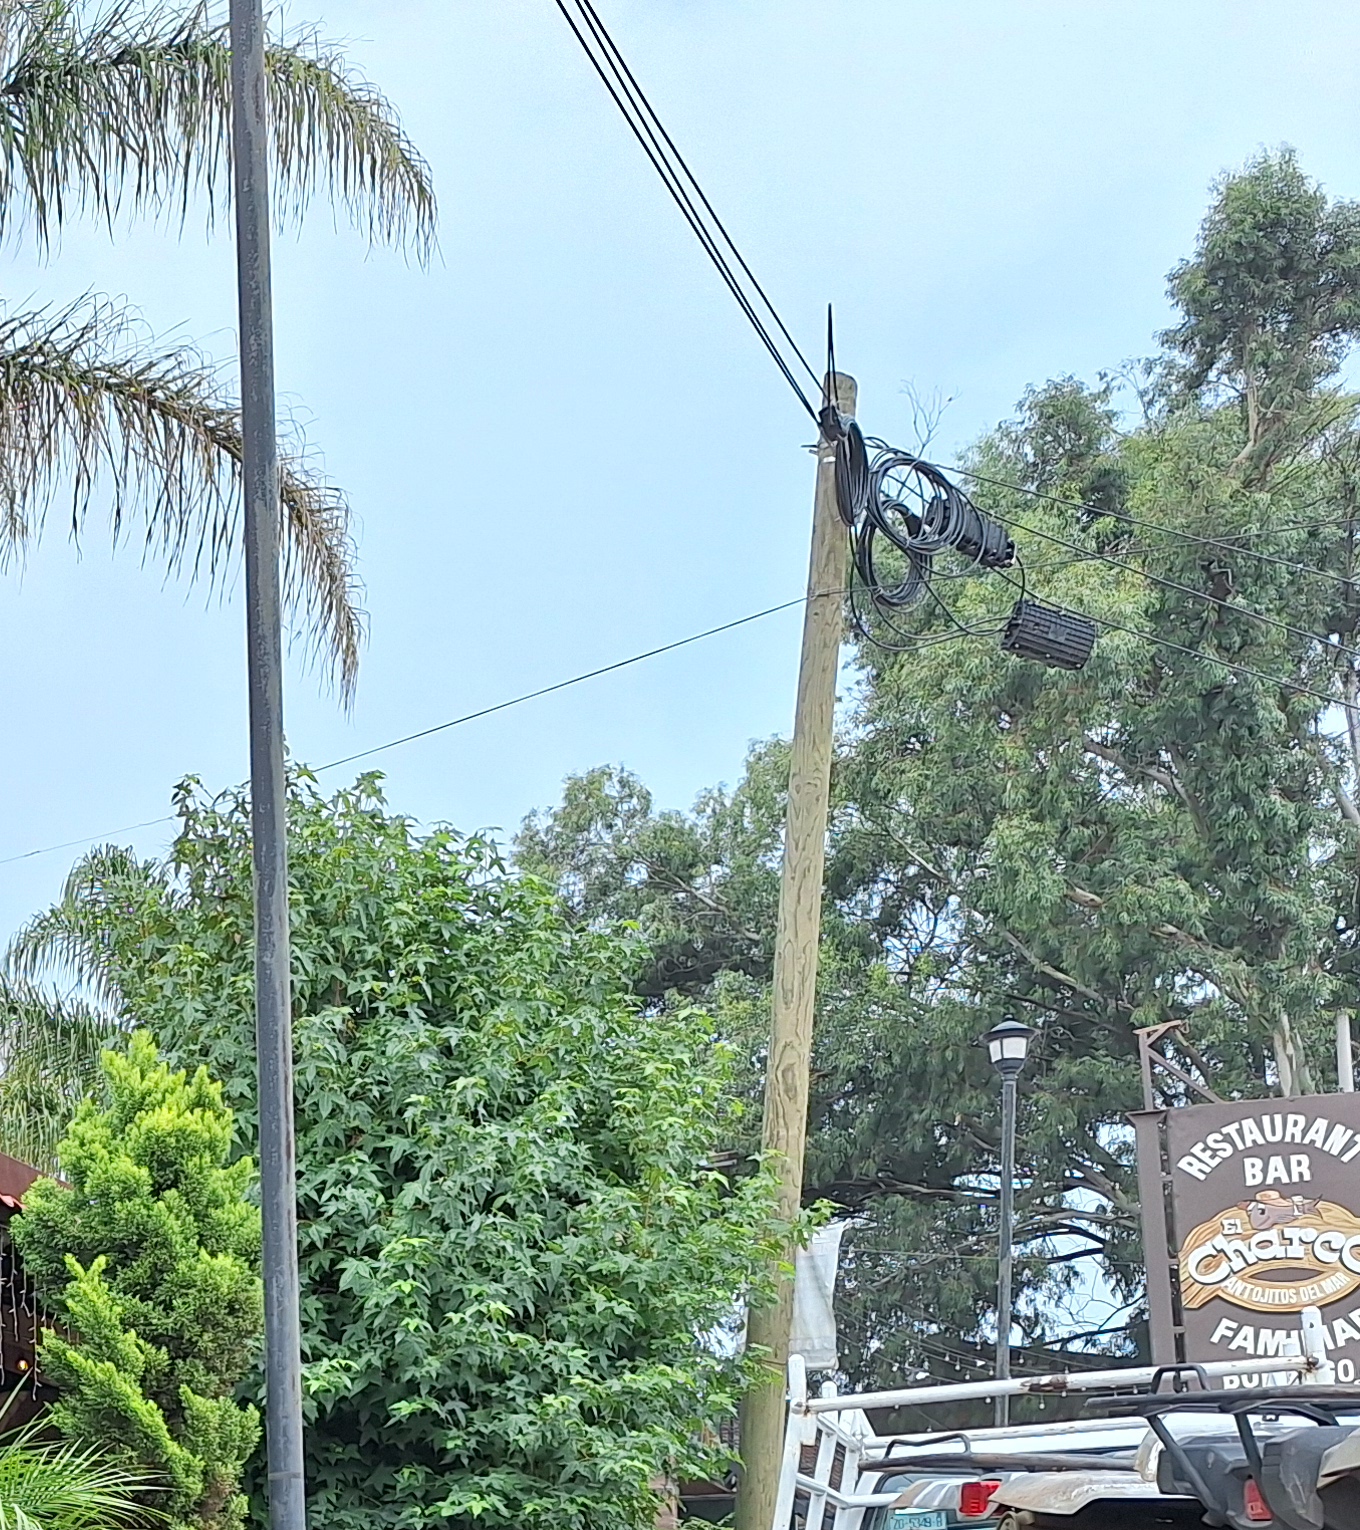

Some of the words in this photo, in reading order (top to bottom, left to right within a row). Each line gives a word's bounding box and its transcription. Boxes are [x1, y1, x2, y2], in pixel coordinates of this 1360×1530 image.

[1243, 1154, 1312, 1187] BAR
[1221, 1219, 1243, 1235] El
[1221, 1276, 1296, 1304] ANTOJITOS
[1299, 1284, 1322, 1302] DEL
[1323, 1271, 1351, 1294] MAR
